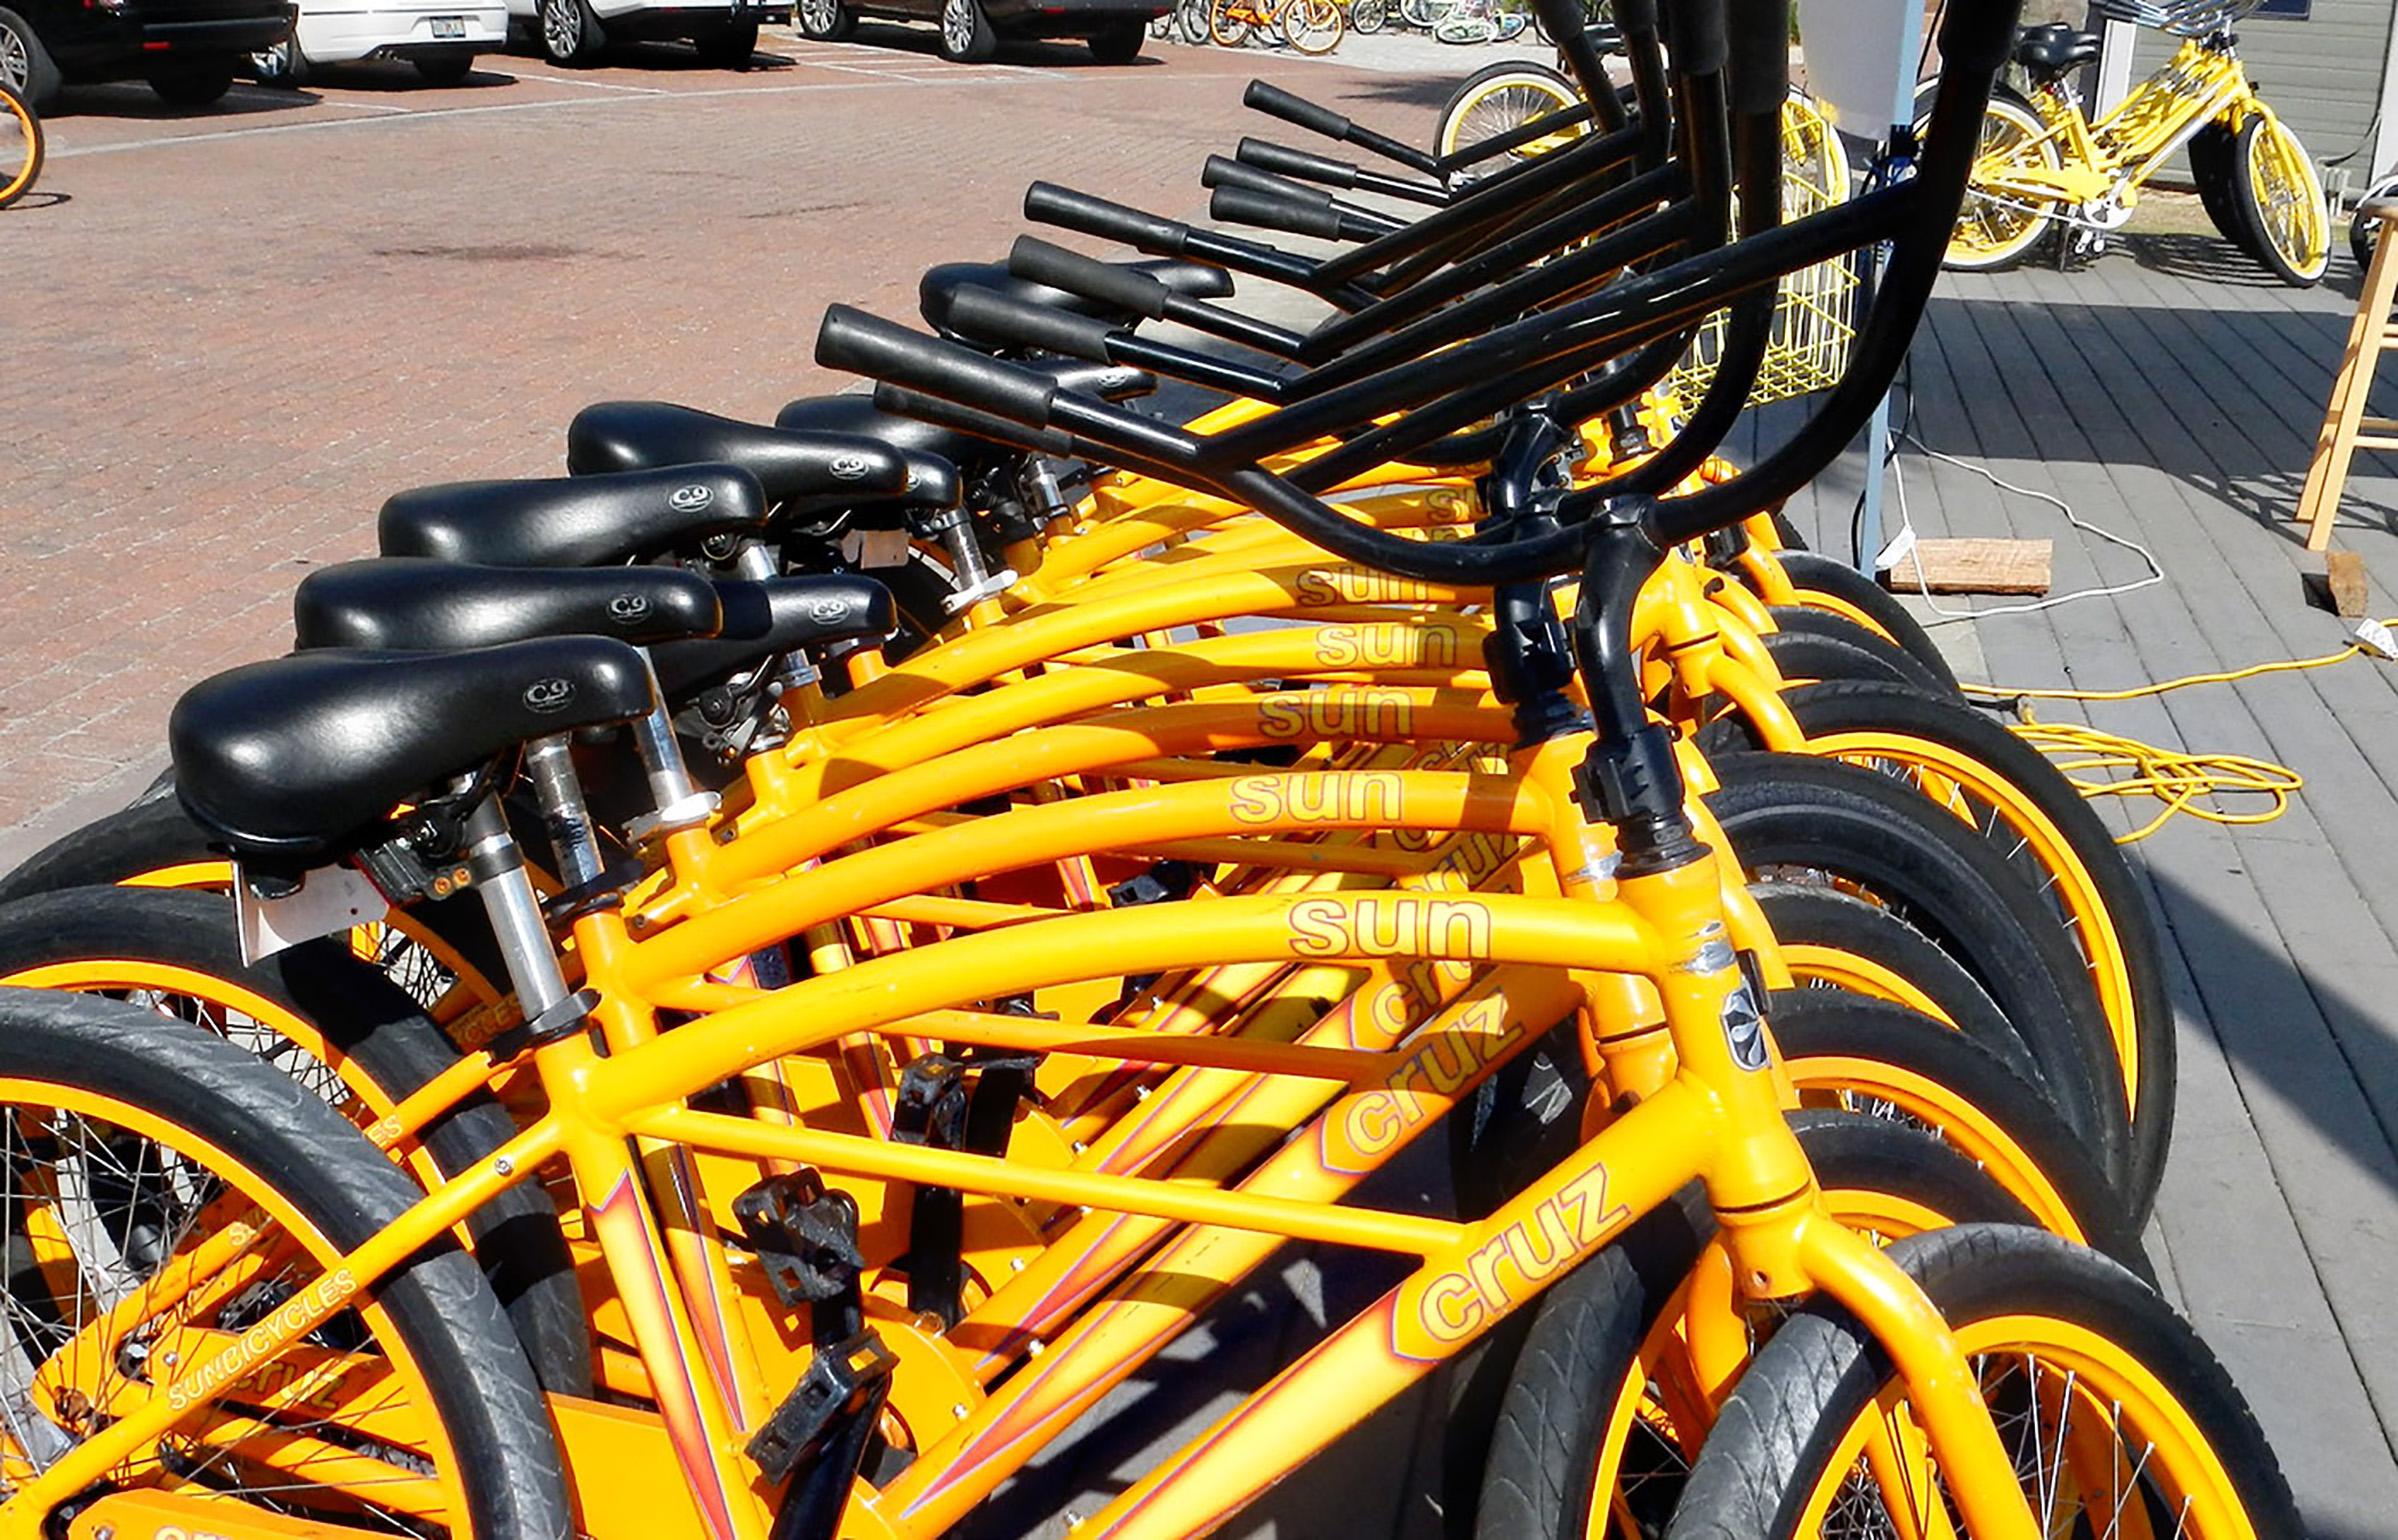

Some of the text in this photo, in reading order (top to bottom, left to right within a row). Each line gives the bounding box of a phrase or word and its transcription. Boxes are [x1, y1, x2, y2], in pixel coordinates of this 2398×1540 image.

[1315, 624, 1457, 667] sun
[1257, 689, 1414, 739] sun
[1230, 772, 1403, 824] sun
[1288, 899, 1491, 959] sun
[1345, 986, 1526, 1157] cruz
[1419, 1162, 1632, 1344] cruz
[168, 1268, 358, 1411] SUNBICYCLES
